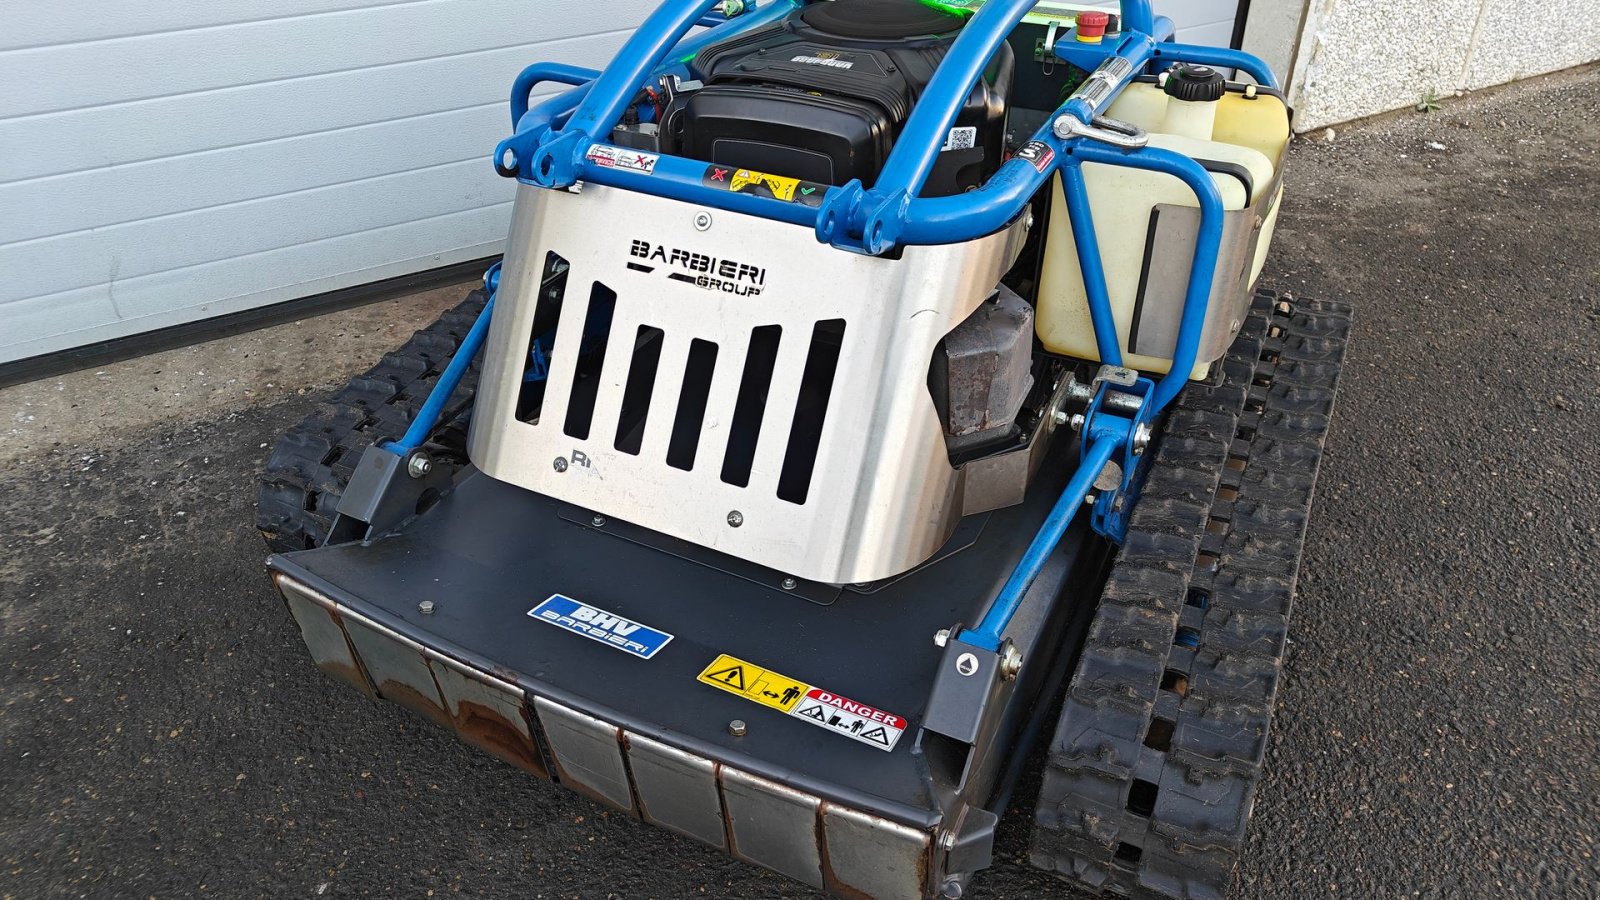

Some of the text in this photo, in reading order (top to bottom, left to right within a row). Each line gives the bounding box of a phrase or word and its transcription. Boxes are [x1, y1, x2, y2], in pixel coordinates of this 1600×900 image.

[630, 239, 766, 285] BARBIERI
[696, 275, 760, 297] GROUP
[569, 605, 642, 637] BHV
[818, 692, 898, 727] DANGER
